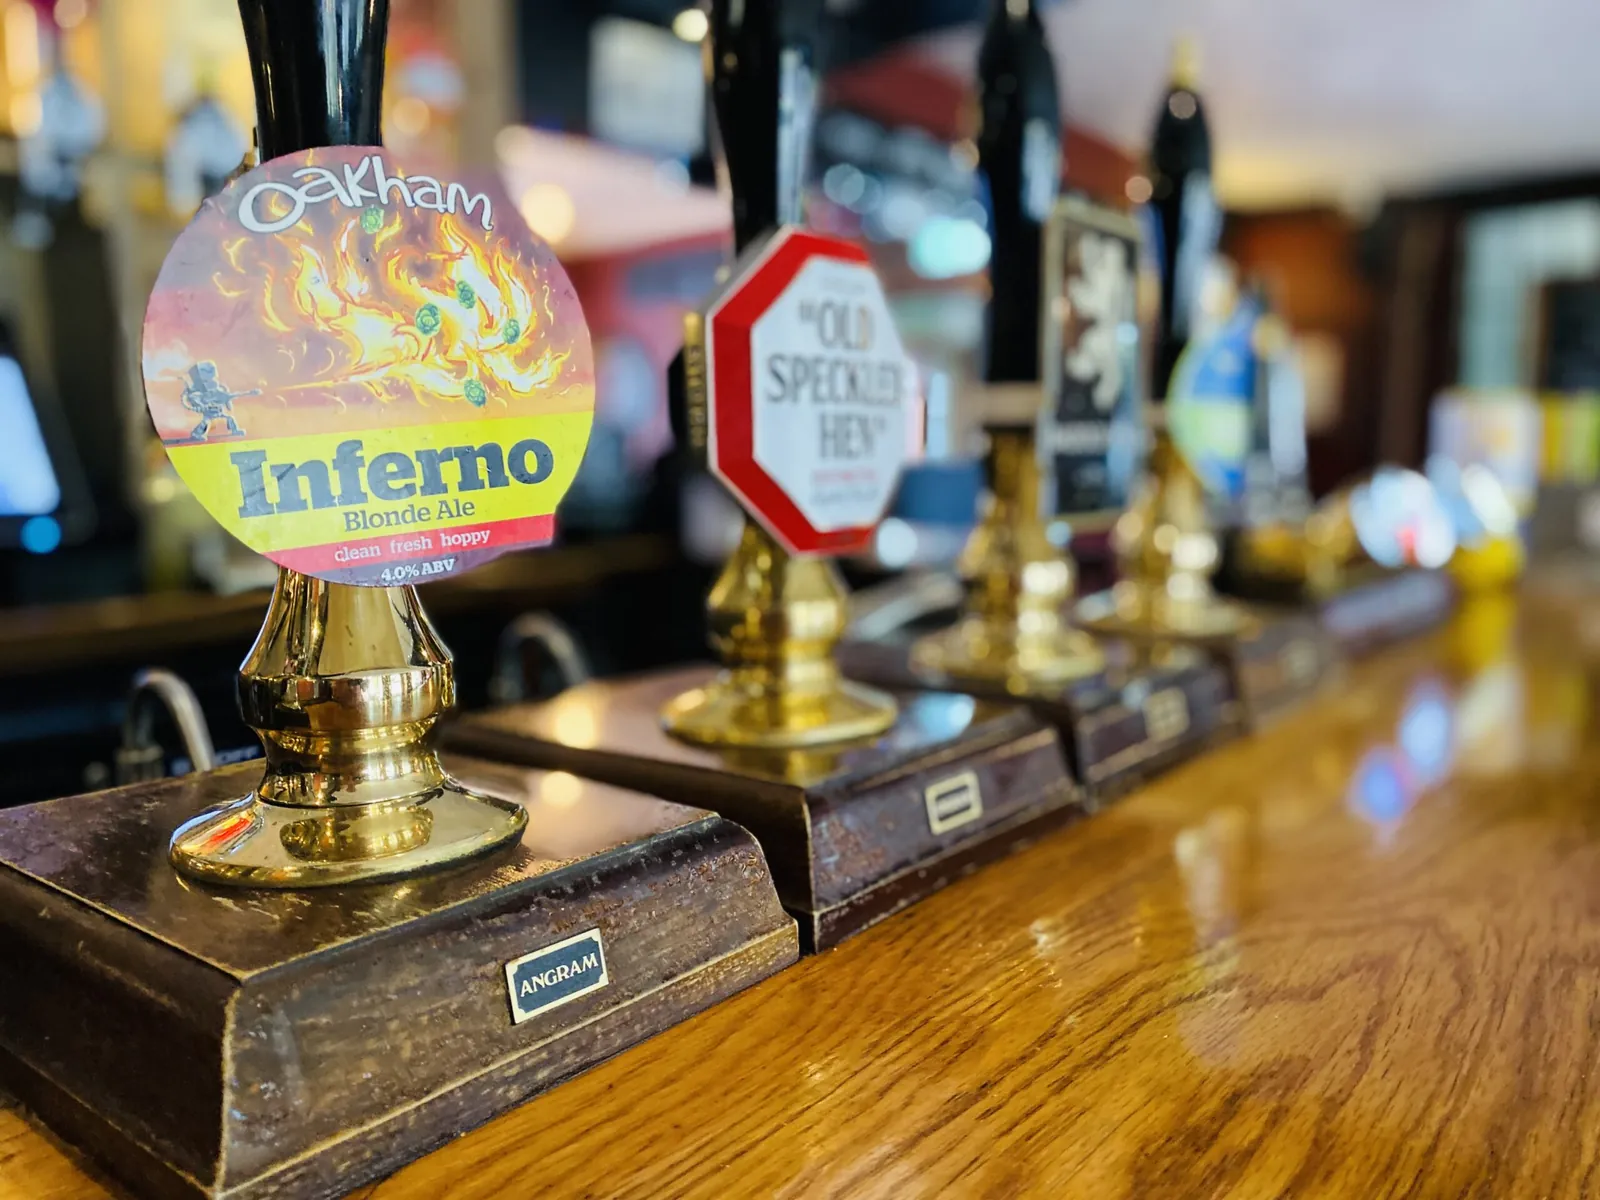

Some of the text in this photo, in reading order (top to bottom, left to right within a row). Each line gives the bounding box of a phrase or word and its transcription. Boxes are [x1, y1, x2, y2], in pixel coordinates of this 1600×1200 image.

[237, 154, 494, 234] Oakham
[230, 438, 554, 518] Inferno
[343, 499, 476, 532] Blonde Ale
[334, 529, 491, 563] clean fresh hoppy
[381, 558, 455, 581] 4.0% ABV
[520, 952, 599, 998] ANGRAM
